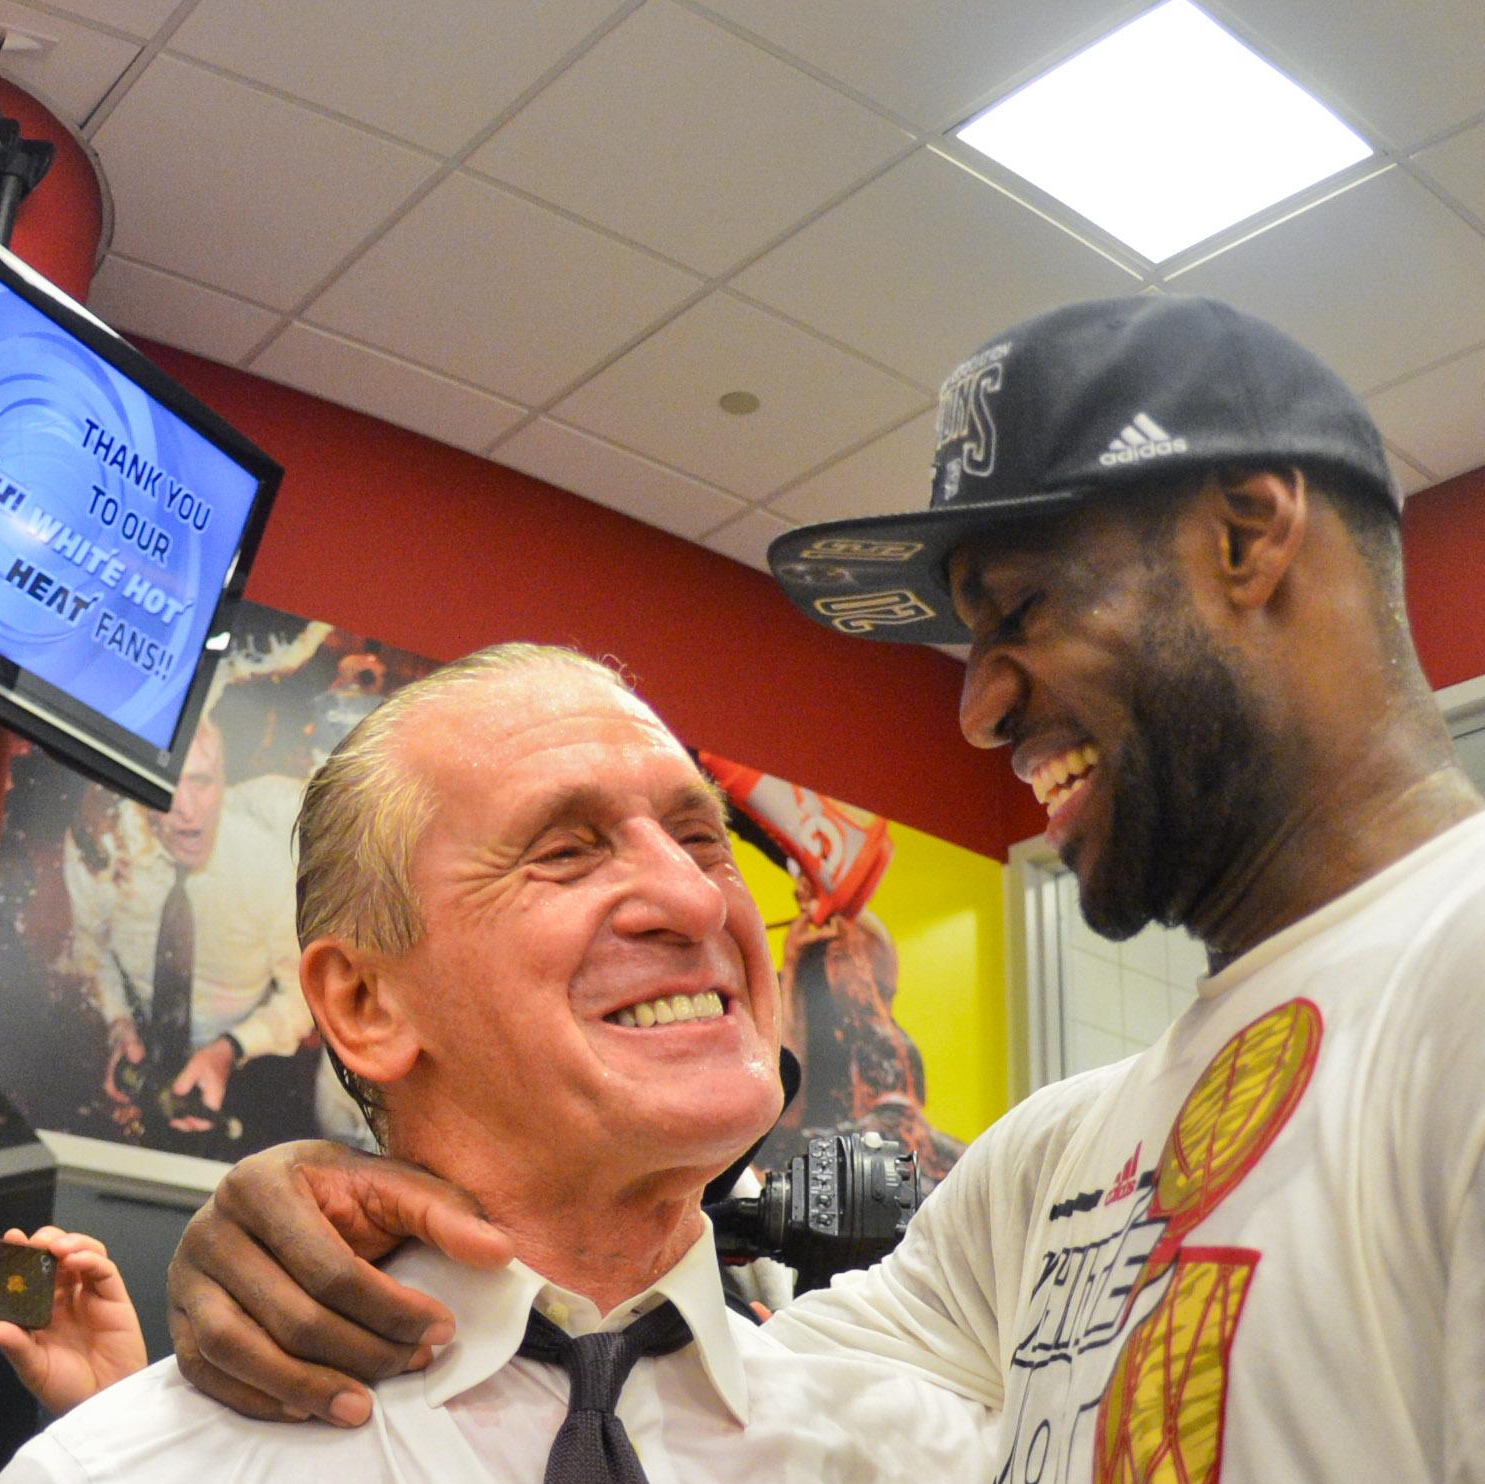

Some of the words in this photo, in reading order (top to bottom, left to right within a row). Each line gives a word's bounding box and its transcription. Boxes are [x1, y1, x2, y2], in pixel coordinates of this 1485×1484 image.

[82, 418, 163, 498] THANK
[166, 479, 211, 531] YOU
[1099, 437, 1188, 466] adidas
[27, 505, 127, 588] WHITE
[122, 573, 194, 624] HOT
[89, 485, 118, 526] TO
[122, 512, 170, 563] OUR
[5, 558, 99, 622] HEAT
[95, 611, 174, 680] FANS!!
